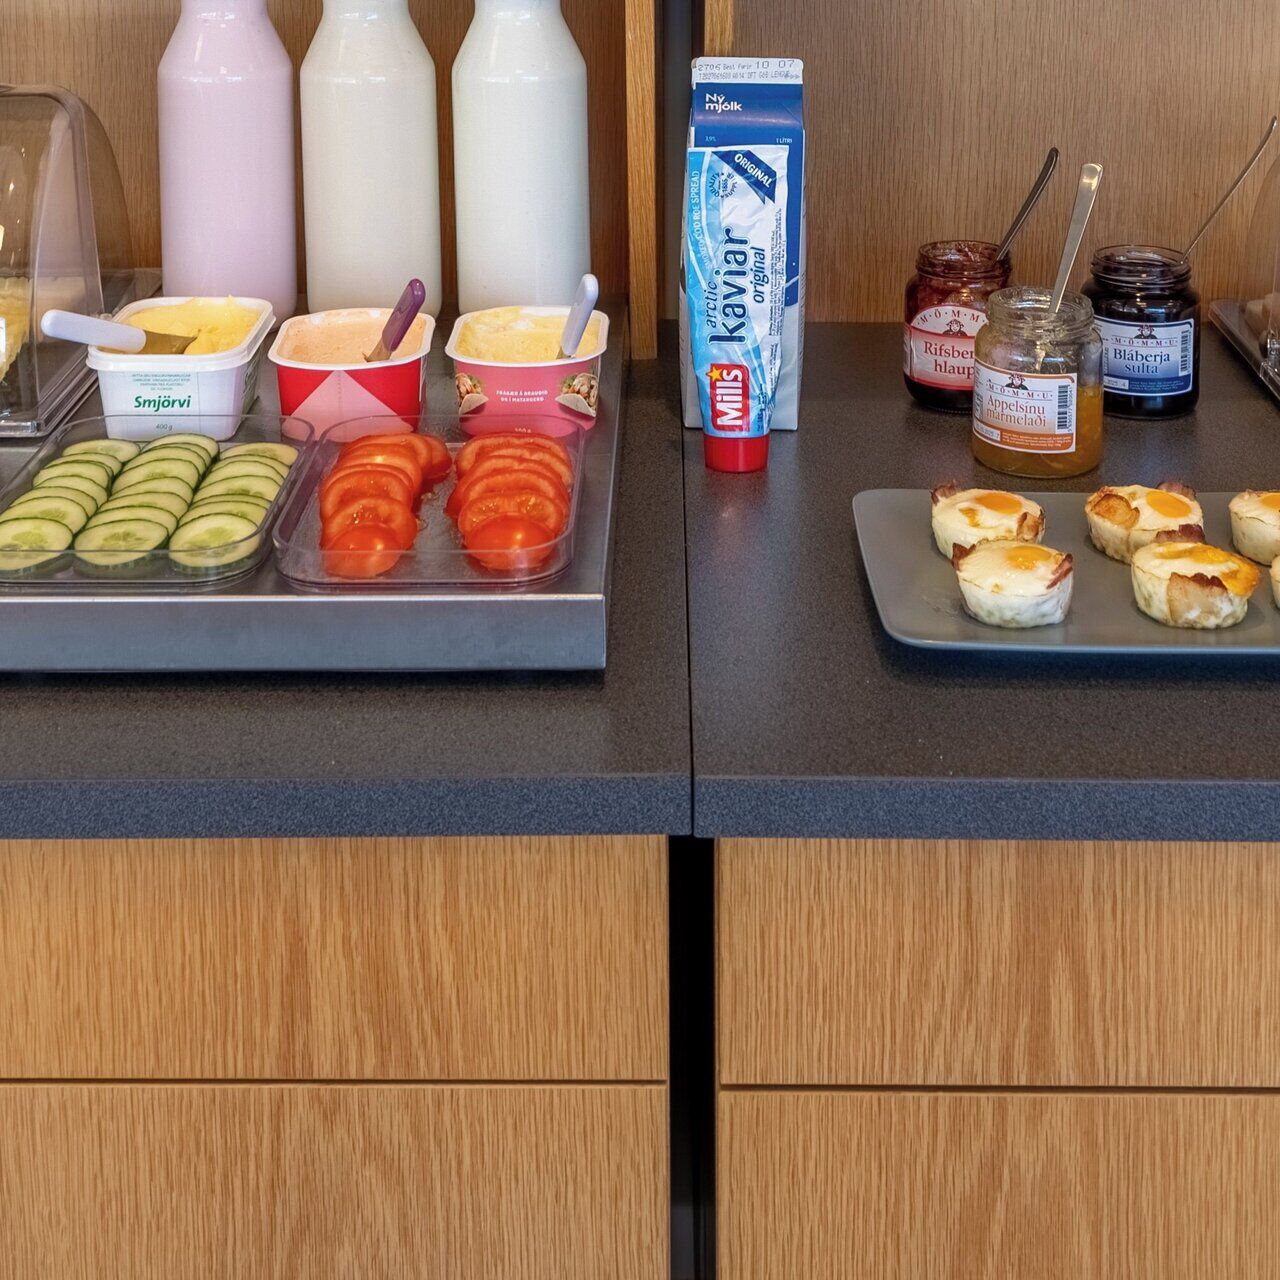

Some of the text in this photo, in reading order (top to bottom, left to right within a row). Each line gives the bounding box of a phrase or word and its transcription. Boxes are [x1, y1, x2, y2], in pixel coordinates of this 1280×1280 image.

[705, 101, 742, 113] mjólk
[734, 153, 773, 188] ORIGINAL
[690, 170, 700, 203] SPREAD
[692, 204, 700, 220] ROE
[693, 221, 703, 239] COD
[708, 227, 748, 343] kaviar
[750, 246, 769, 304] original
[704, 281, 717, 328] arctic
[923, 341, 975, 359] Rifsber
[1113, 348, 1170, 365] Bláberja
[1124, 363, 1158, 374] sulta
[134, 395, 191, 412] Smjörvi
[716, 369, 743, 426] Mills
[987, 395, 1045, 415] Appelsínu
[986, 407, 1046, 427] marmelaði
